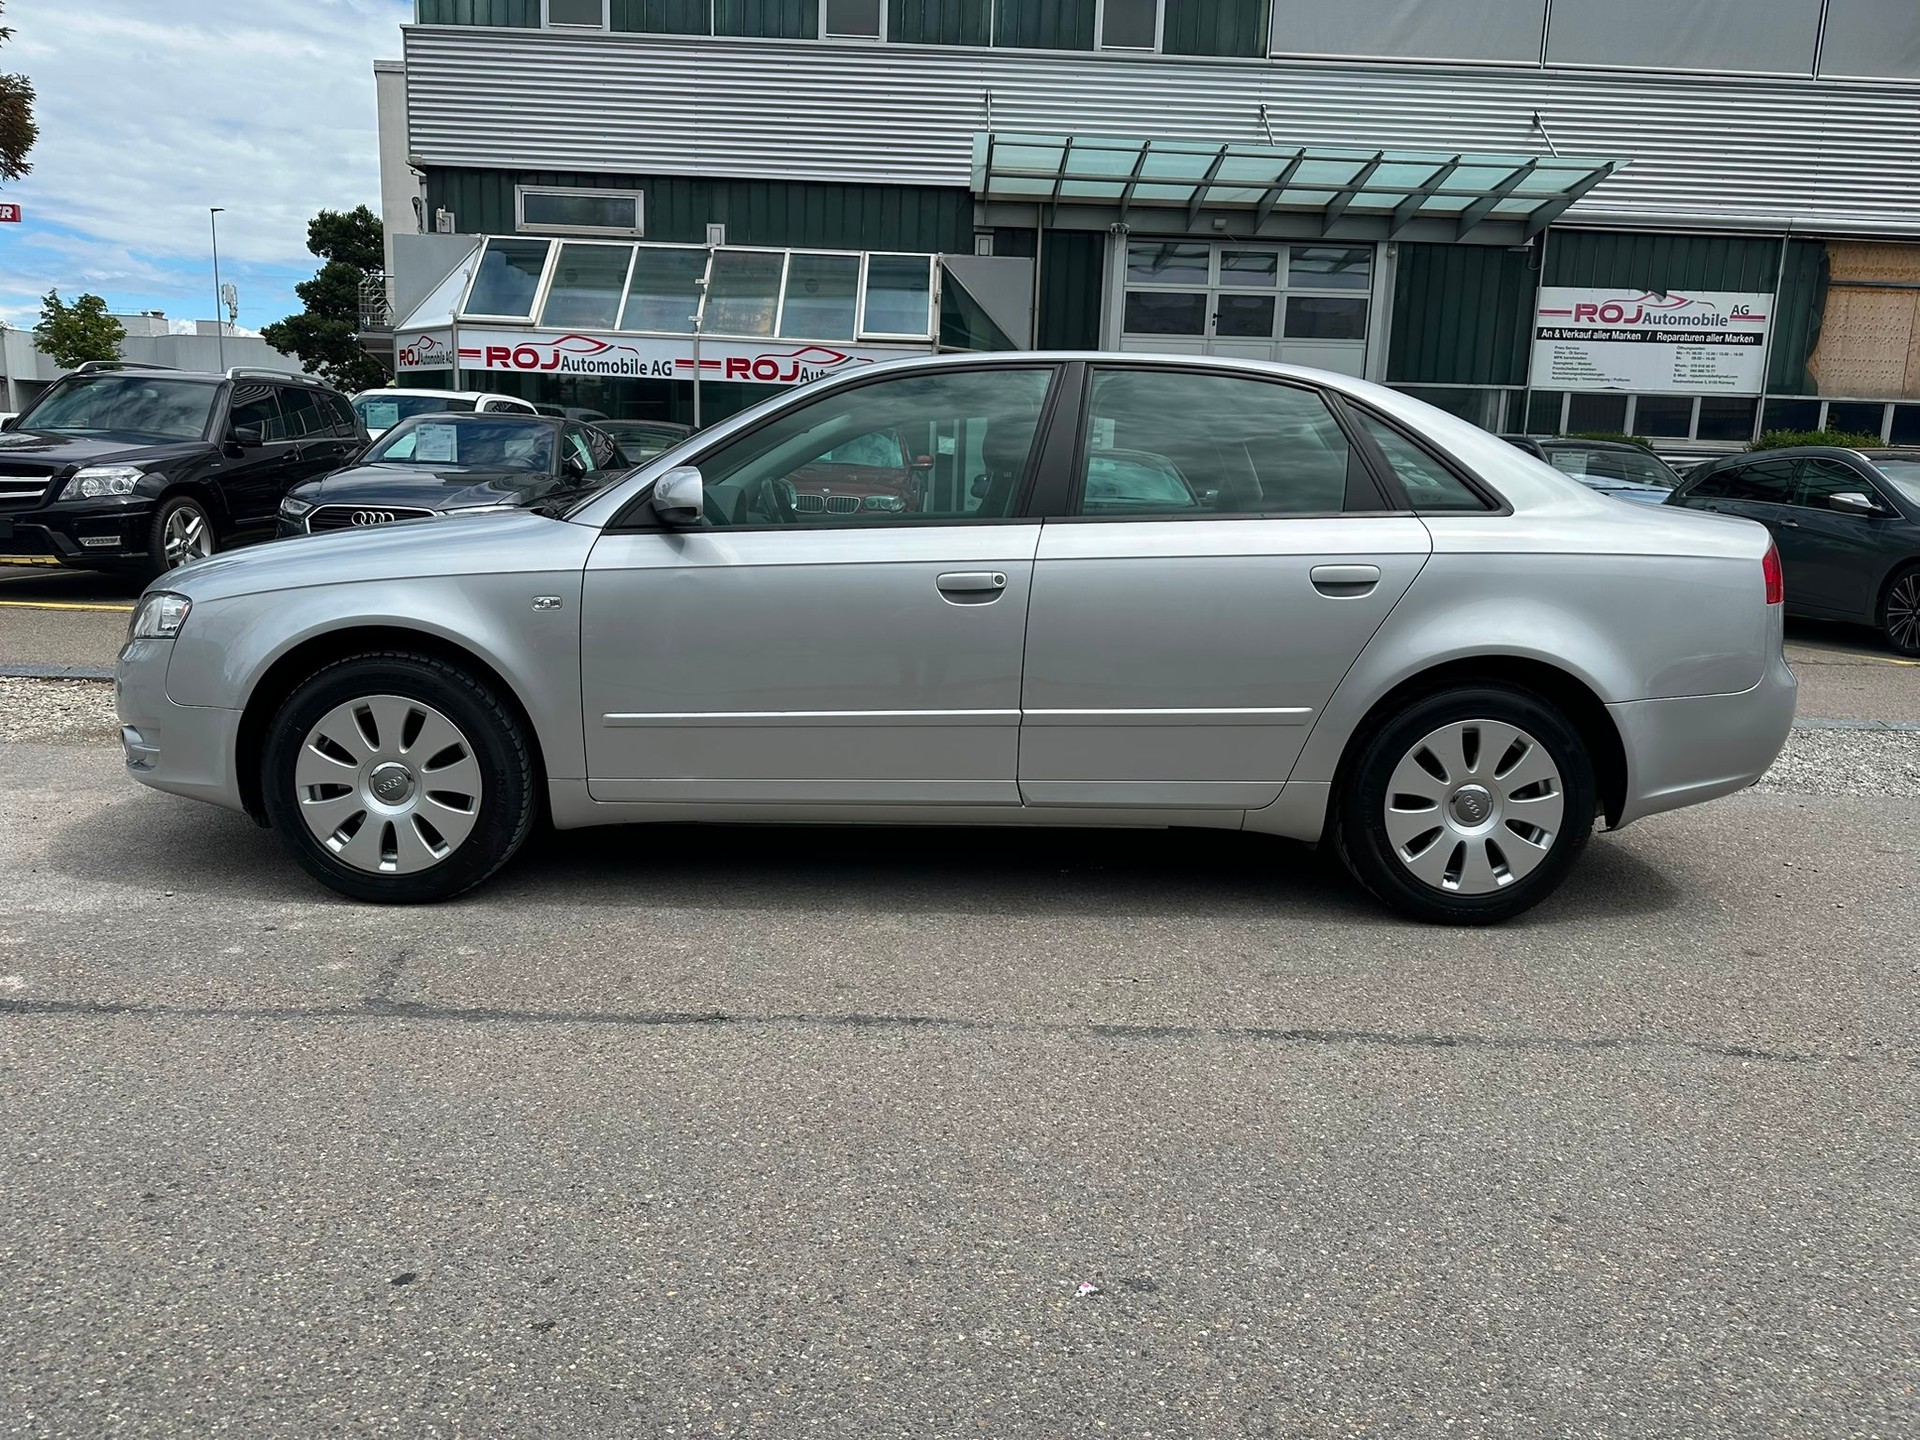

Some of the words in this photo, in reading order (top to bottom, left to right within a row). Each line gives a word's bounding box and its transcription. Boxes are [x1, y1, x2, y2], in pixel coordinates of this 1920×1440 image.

[0, 205, 13, 219] R
[1574, 303, 1643, 324] ROJ
[1641, 312, 1728, 326] Automobile
[1731, 304, 1750, 315] AG
[1541, 328, 1553, 338] An
[1554, 329, 1561, 338] &
[1562, 329, 1592, 340] Verkauf
[1592, 330, 1610, 340] aller
[1611, 331, 1642, 341] Marken
[1656, 332, 1705, 343] Reparaturen
[1705, 333, 1723, 344] aller
[1724, 334, 1755, 344] Marken
[399, 347, 420, 367] ROJ
[420, 350, 445, 366] Automobile
[445, 350, 453, 365] AG
[486, 346, 560, 370] ROJ
[560, 355, 648, 376] Automobile
[650, 360, 673, 376] AG
[726, 357, 800, 382] ROJ
